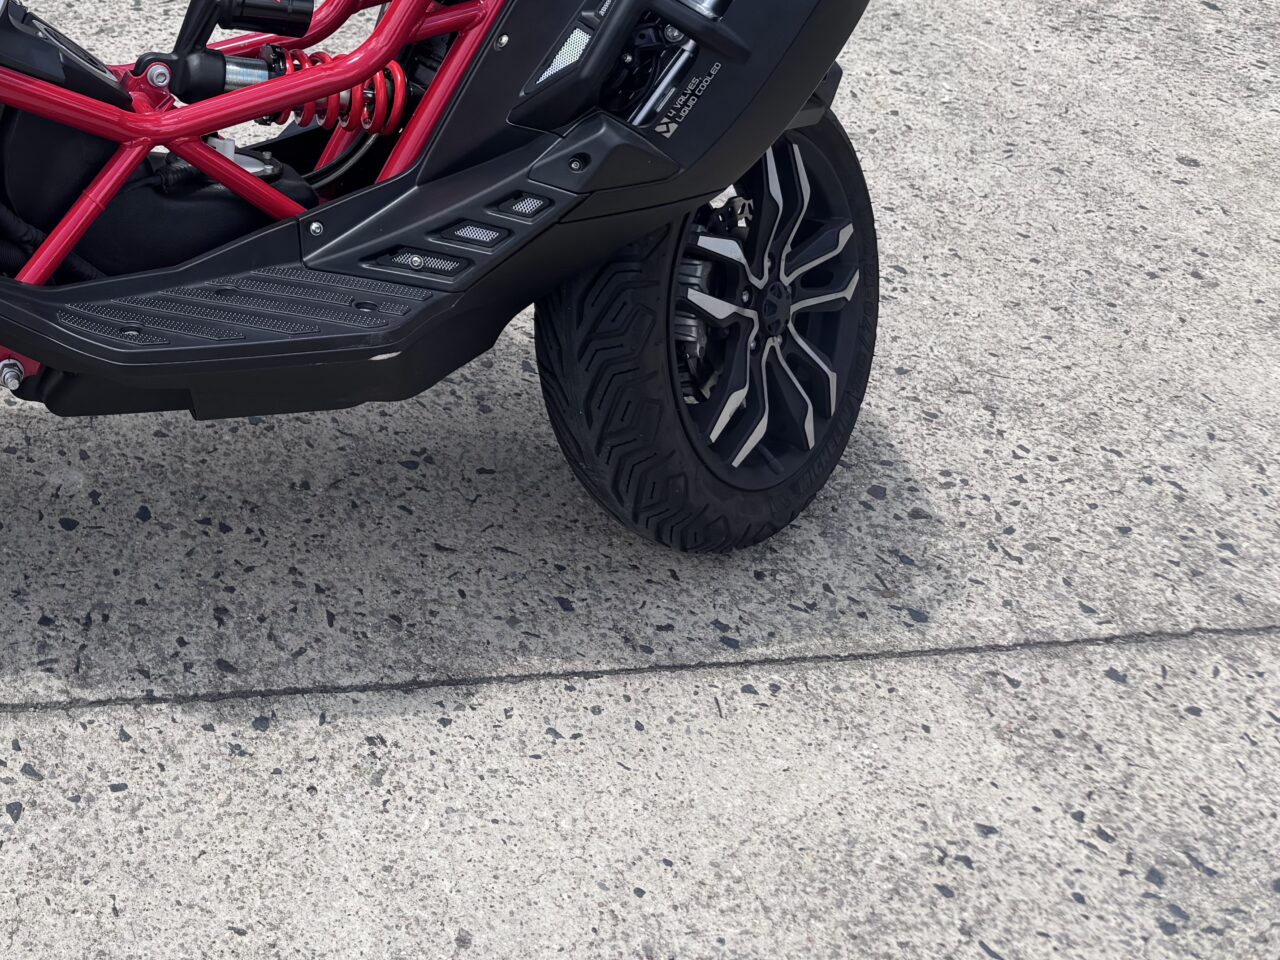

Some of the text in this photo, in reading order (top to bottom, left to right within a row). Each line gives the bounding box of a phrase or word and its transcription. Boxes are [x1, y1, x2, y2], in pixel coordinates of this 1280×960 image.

[675, 62, 722, 122] LIQUID COOLED
[667, 109, 677, 117] 4
